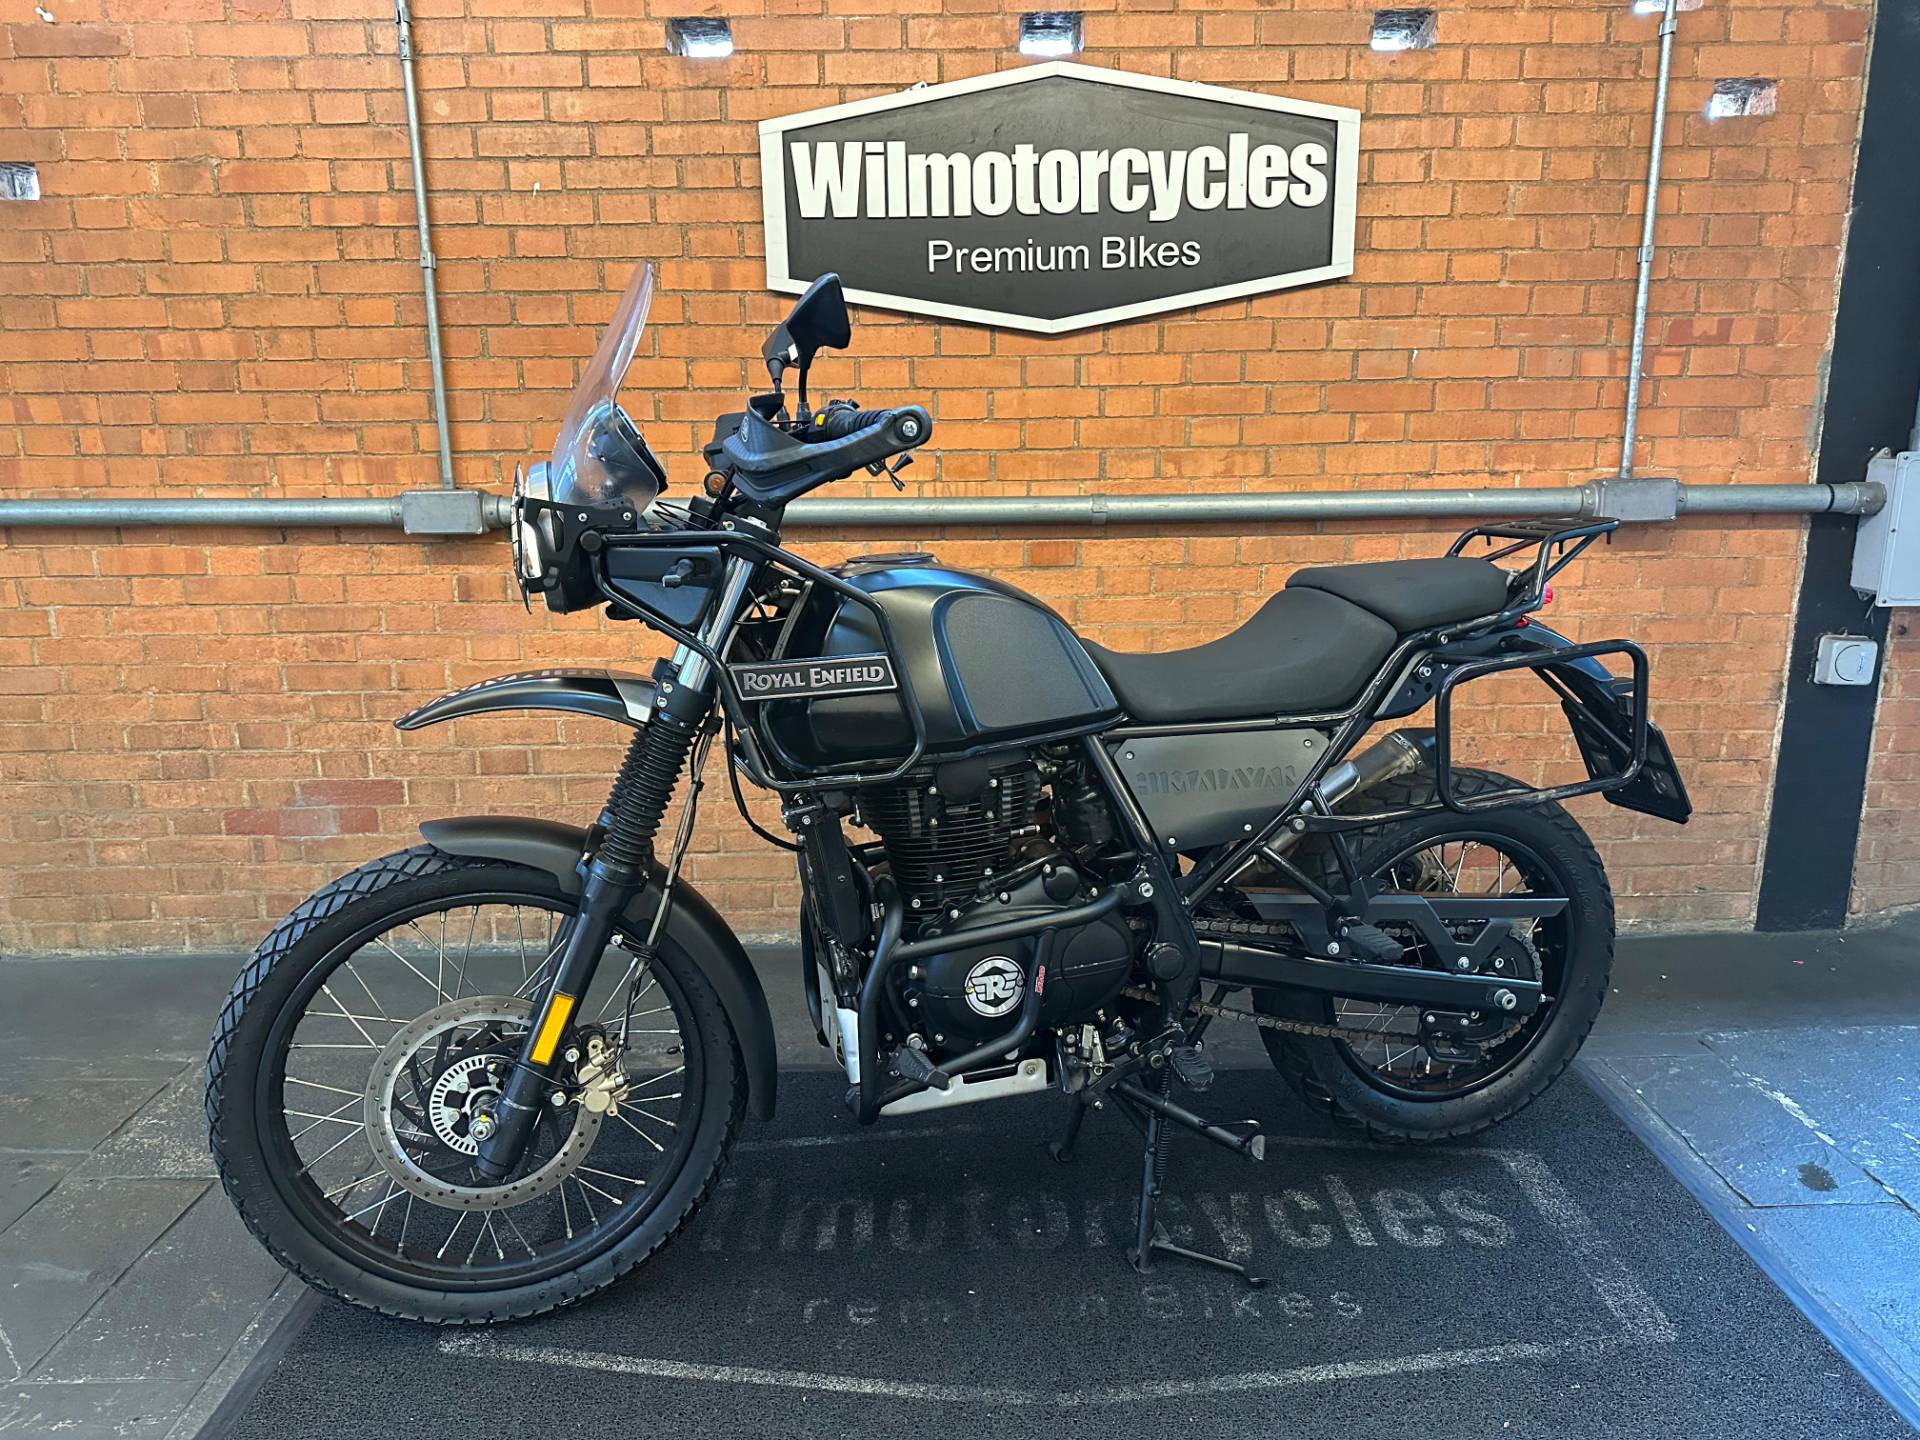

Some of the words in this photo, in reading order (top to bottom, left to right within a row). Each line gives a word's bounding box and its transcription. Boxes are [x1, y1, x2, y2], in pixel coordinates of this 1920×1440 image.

[790, 133, 1329, 222] Wilmotorcycles
[926, 239, 1090, 273] Premium
[743, 672, 806, 692] ROYAL
[809, 666, 885, 688] ENFIELD
